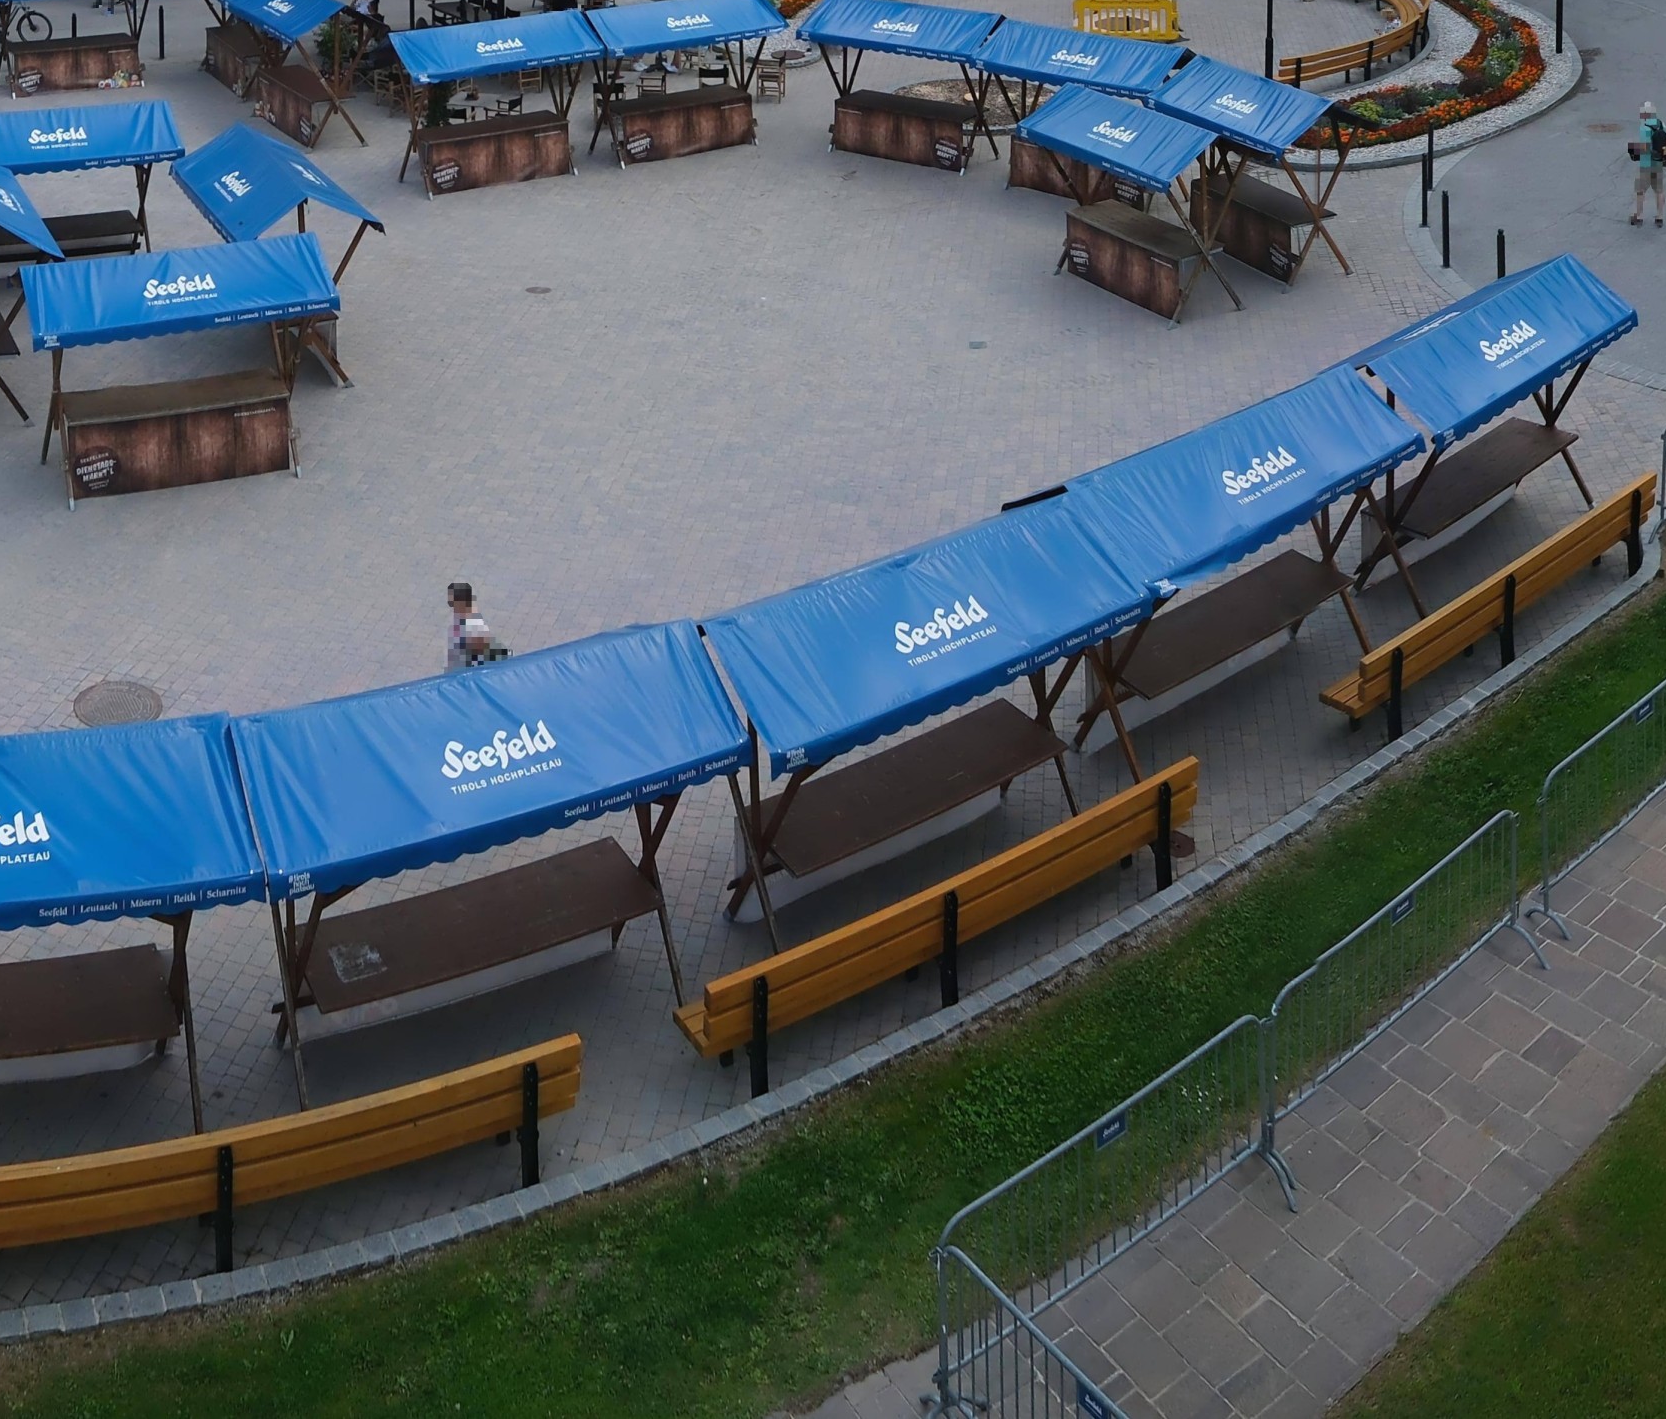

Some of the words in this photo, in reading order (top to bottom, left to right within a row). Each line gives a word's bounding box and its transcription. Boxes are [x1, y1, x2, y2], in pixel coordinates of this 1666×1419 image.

[666, 13, 710, 30] Seefeld
[873, 19, 919, 33] Seefeld
[476, 36, 523, 54] Seefeld
[1051, 49, 1100, 67] Seefeld
[1215, 93, 1259, 115] Seefeld
[27, 126, 87, 145] Seefeld
[1092, 120, 1138, 144] Seefeld
[220, 170, 253, 197] Seefeld
[143, 273, 217, 300] Seefeld
[147, 297, 170, 307] TIROLS
[171, 292, 218, 305] HOCHPLATEAU
[1479, 319, 1537, 363] Seefeld
[1222, 445, 1297, 496] Seefeld
[894, 594, 989, 654] Seefeld
[907, 650, 938, 668] TIROLS
[939, 623, 998, 655] HOCHPLATEAU
[440, 719, 557, 780] Seefeld
[450, 777, 488, 796] TIROLS
[490, 756, 563, 786] HOCHPLATEAU
[564, 803, 590, 818] Seefeld
[600, 791, 632, 809] Leutasch
[642, 779, 670, 795] Mösern
[678, 769, 697, 784] Reith
[705, 754, 739, 774] Scharnitz
[38, 905, 68, 919] Seefeld
[80, 900, 119, 915] Leutasch
[130, 894, 163, 910] Mösern
[173, 891, 196, 904] Reith
[206, 885, 247, 901] Scharnitz
